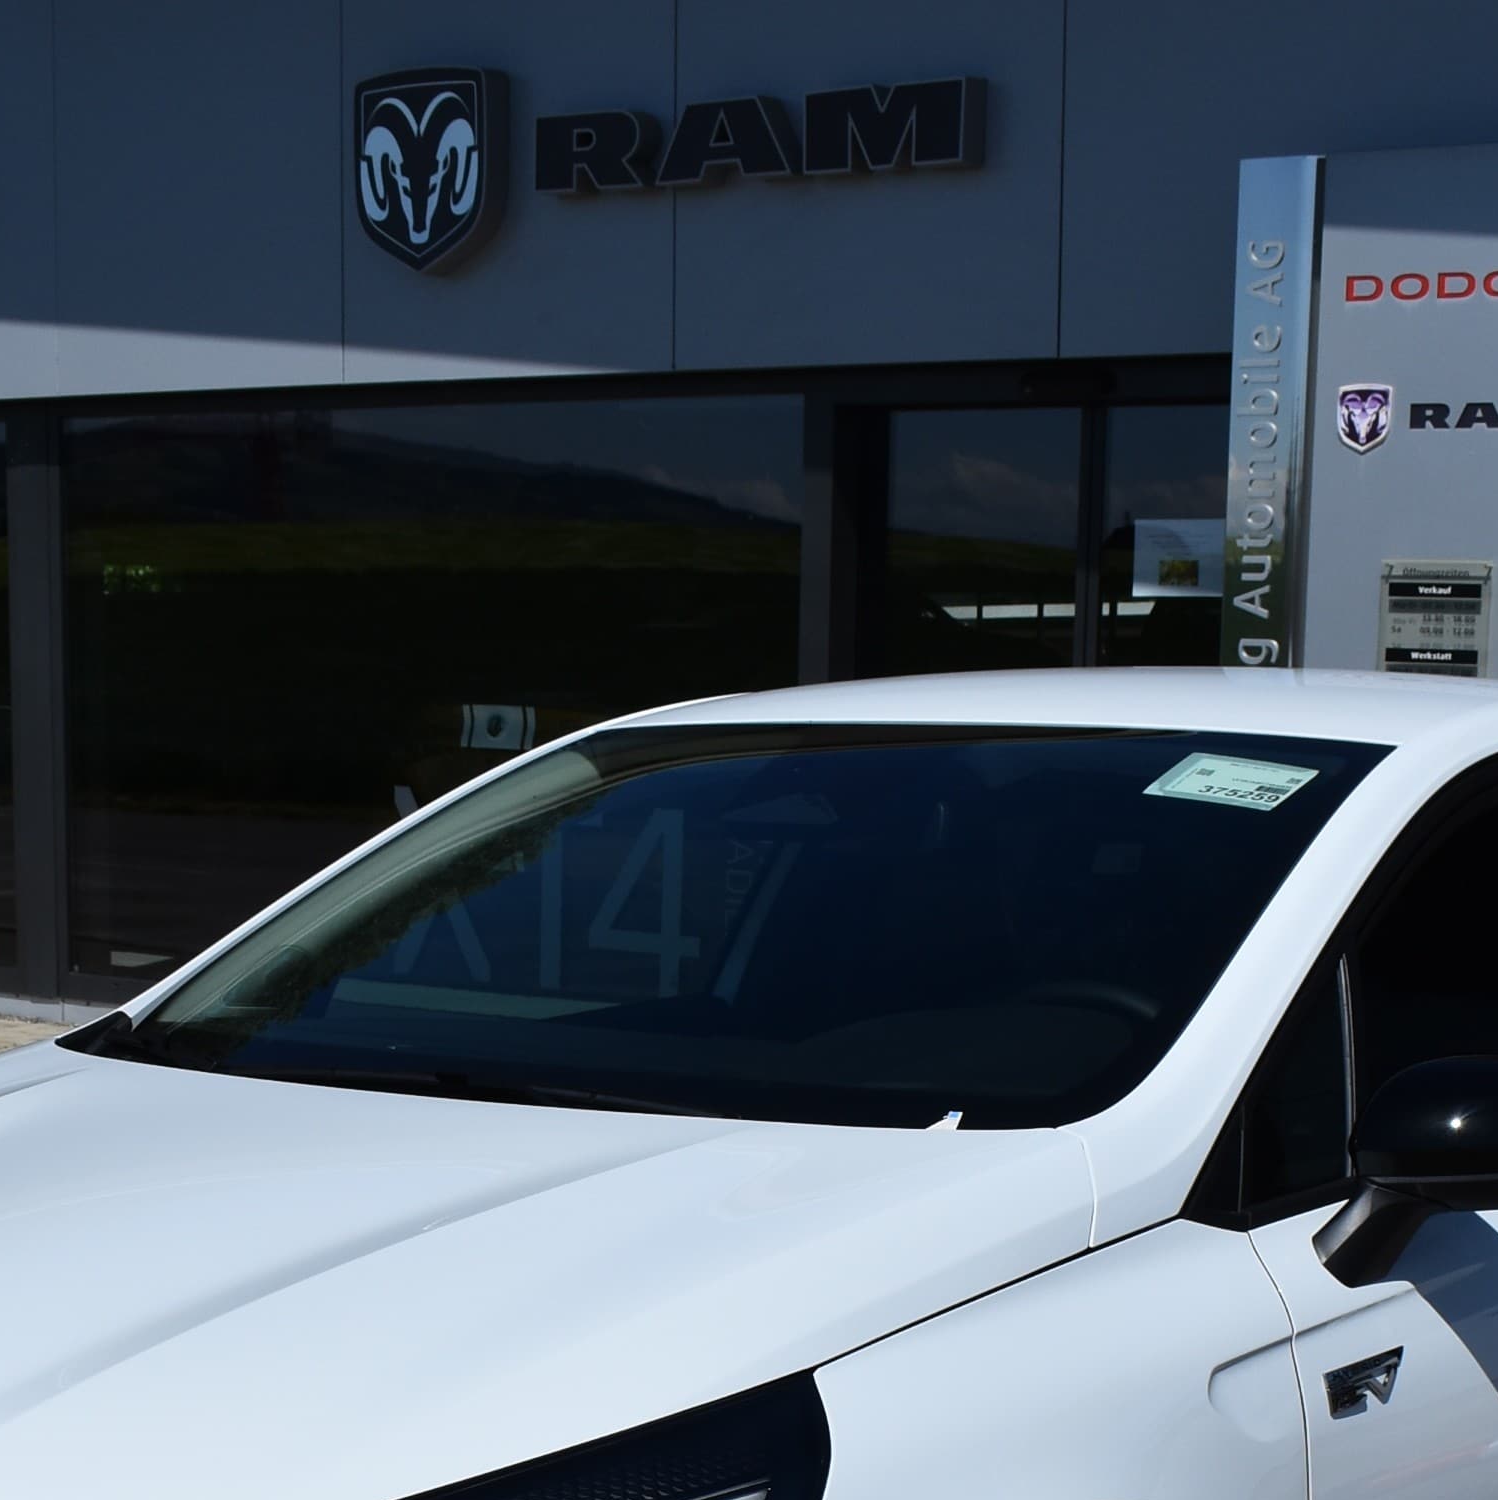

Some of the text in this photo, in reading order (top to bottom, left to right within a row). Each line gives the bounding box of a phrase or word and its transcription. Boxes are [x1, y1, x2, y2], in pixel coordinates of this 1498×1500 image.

[534, 76, 987, 194] RAM
[1248, 240, 1286, 305] AG
[1233, 323, 1283, 619] Automobile
[1418, 586, 1452, 595] Verkauf
[1410, 652, 1453, 661] Werkstatt
[1198, 784, 1280, 804] 375259
